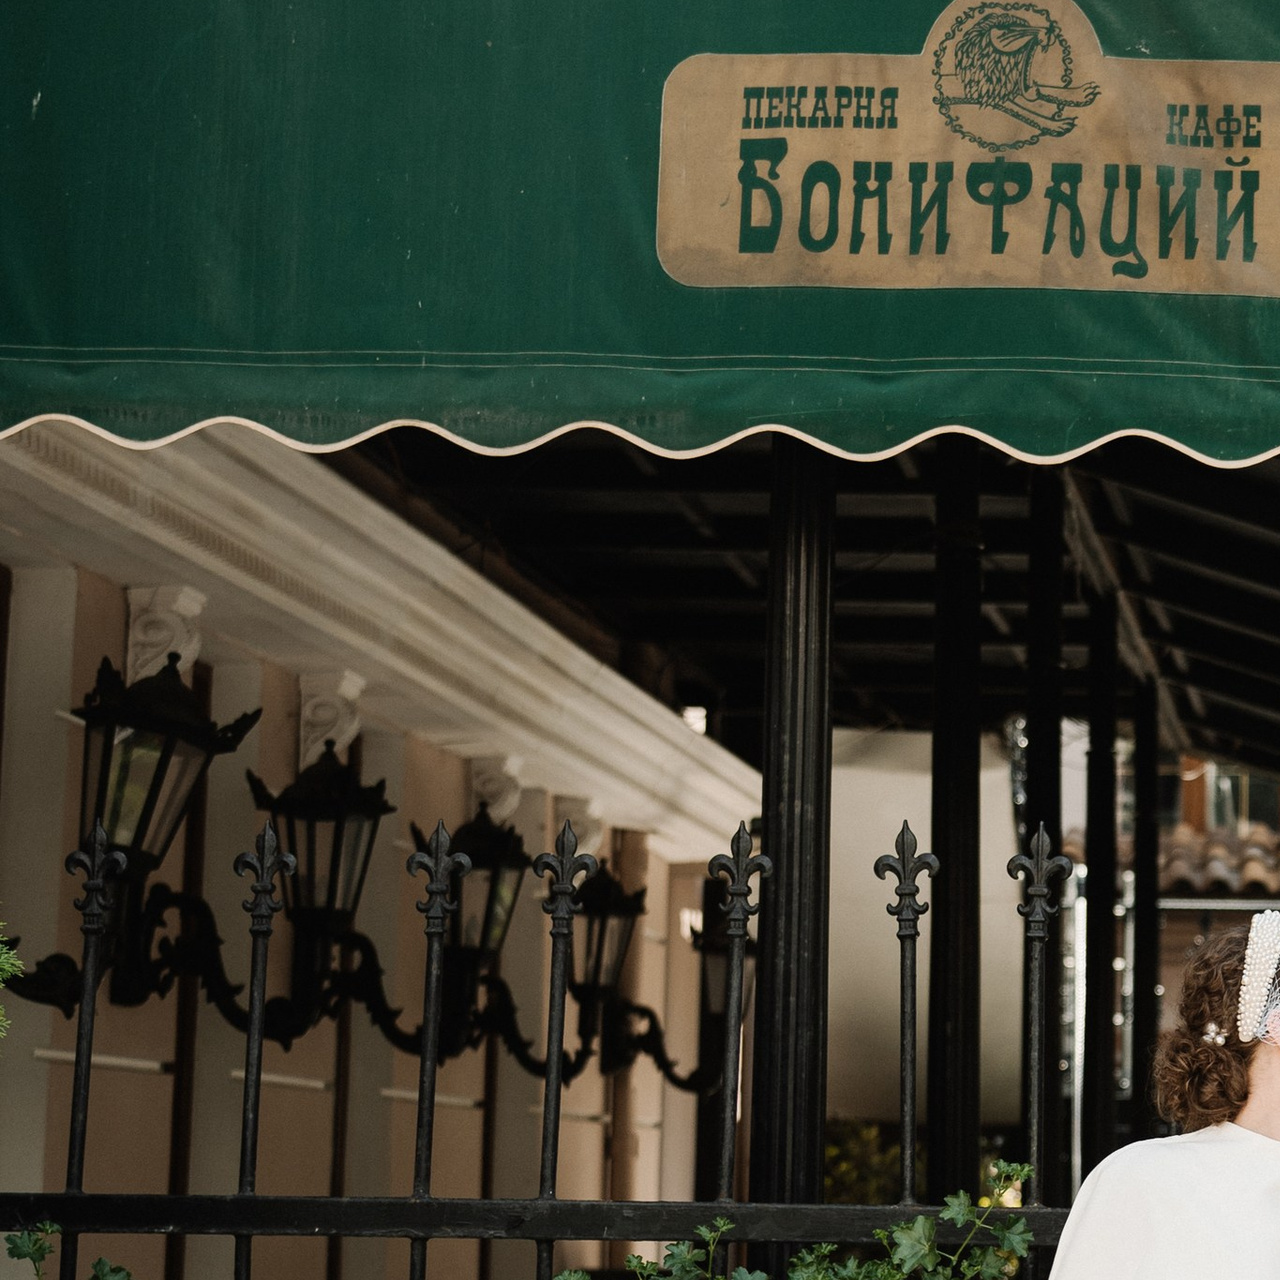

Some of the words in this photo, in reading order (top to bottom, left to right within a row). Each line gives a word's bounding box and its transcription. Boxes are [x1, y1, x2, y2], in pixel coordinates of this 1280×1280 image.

[742, 85, 899, 129] ПЕКАРНЯ
[1165, 103, 1262, 148] КАФЕ
[737, 137, 1260, 279] БОНИФАЦИЙ
